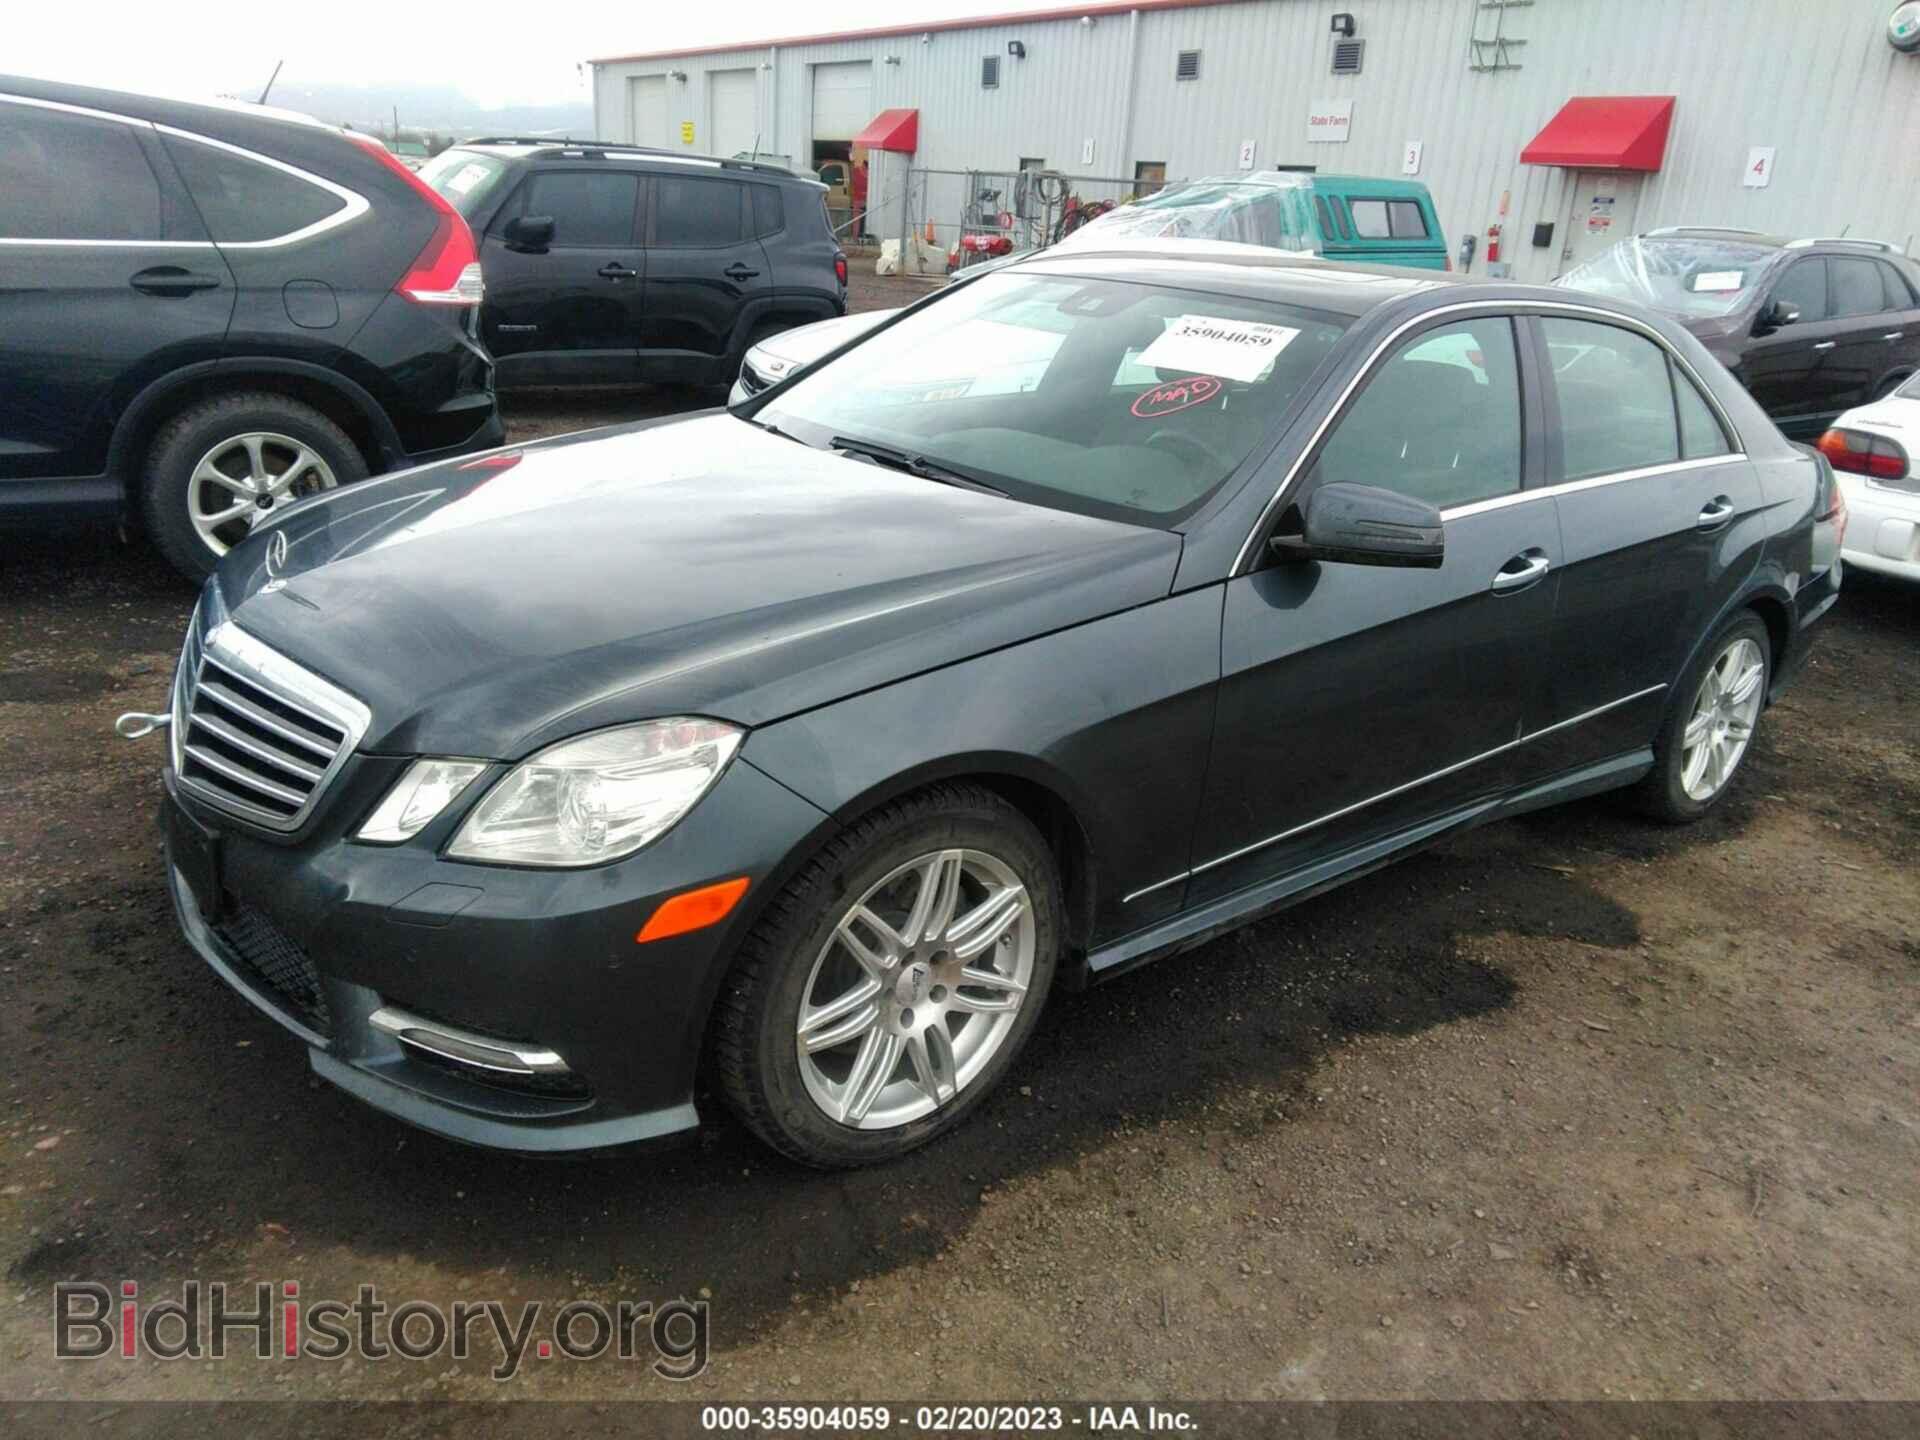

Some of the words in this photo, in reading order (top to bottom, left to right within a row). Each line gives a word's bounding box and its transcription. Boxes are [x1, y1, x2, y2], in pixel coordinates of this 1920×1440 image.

[1408, 150, 1416, 164] 3
[1753, 158, 1766, 175] 4
[1175, 326, 1273, 346] 35904059
